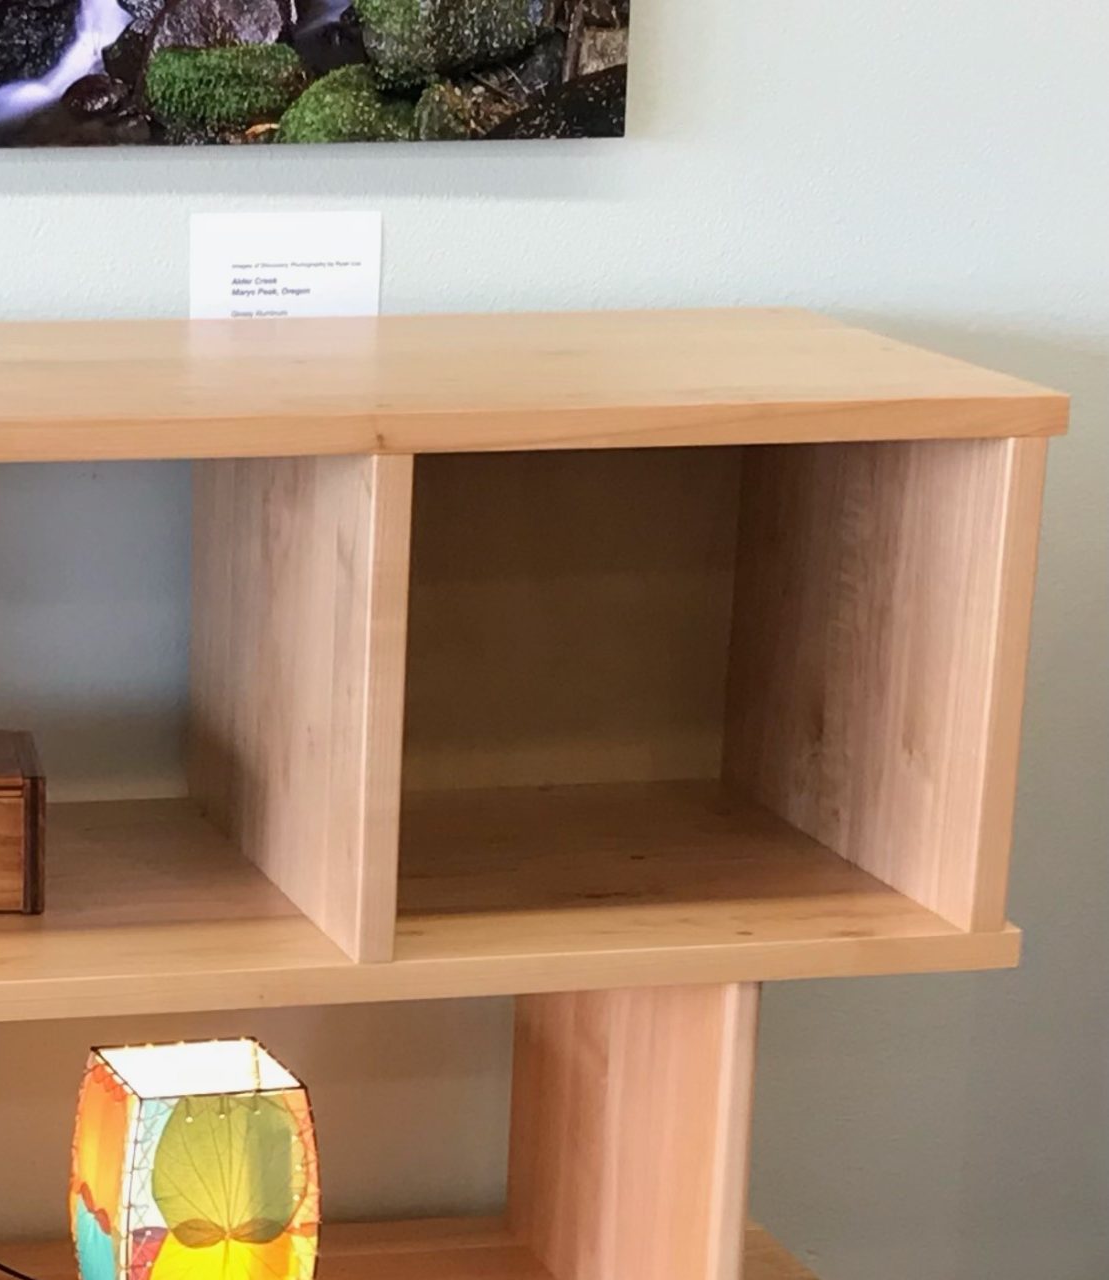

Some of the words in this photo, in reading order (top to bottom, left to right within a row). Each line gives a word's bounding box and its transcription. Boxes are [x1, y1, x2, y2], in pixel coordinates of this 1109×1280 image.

[232, 289, 255, 297] Marys
[258, 288, 279, 296] Peak,
[281, 287, 310, 295] Oregon
